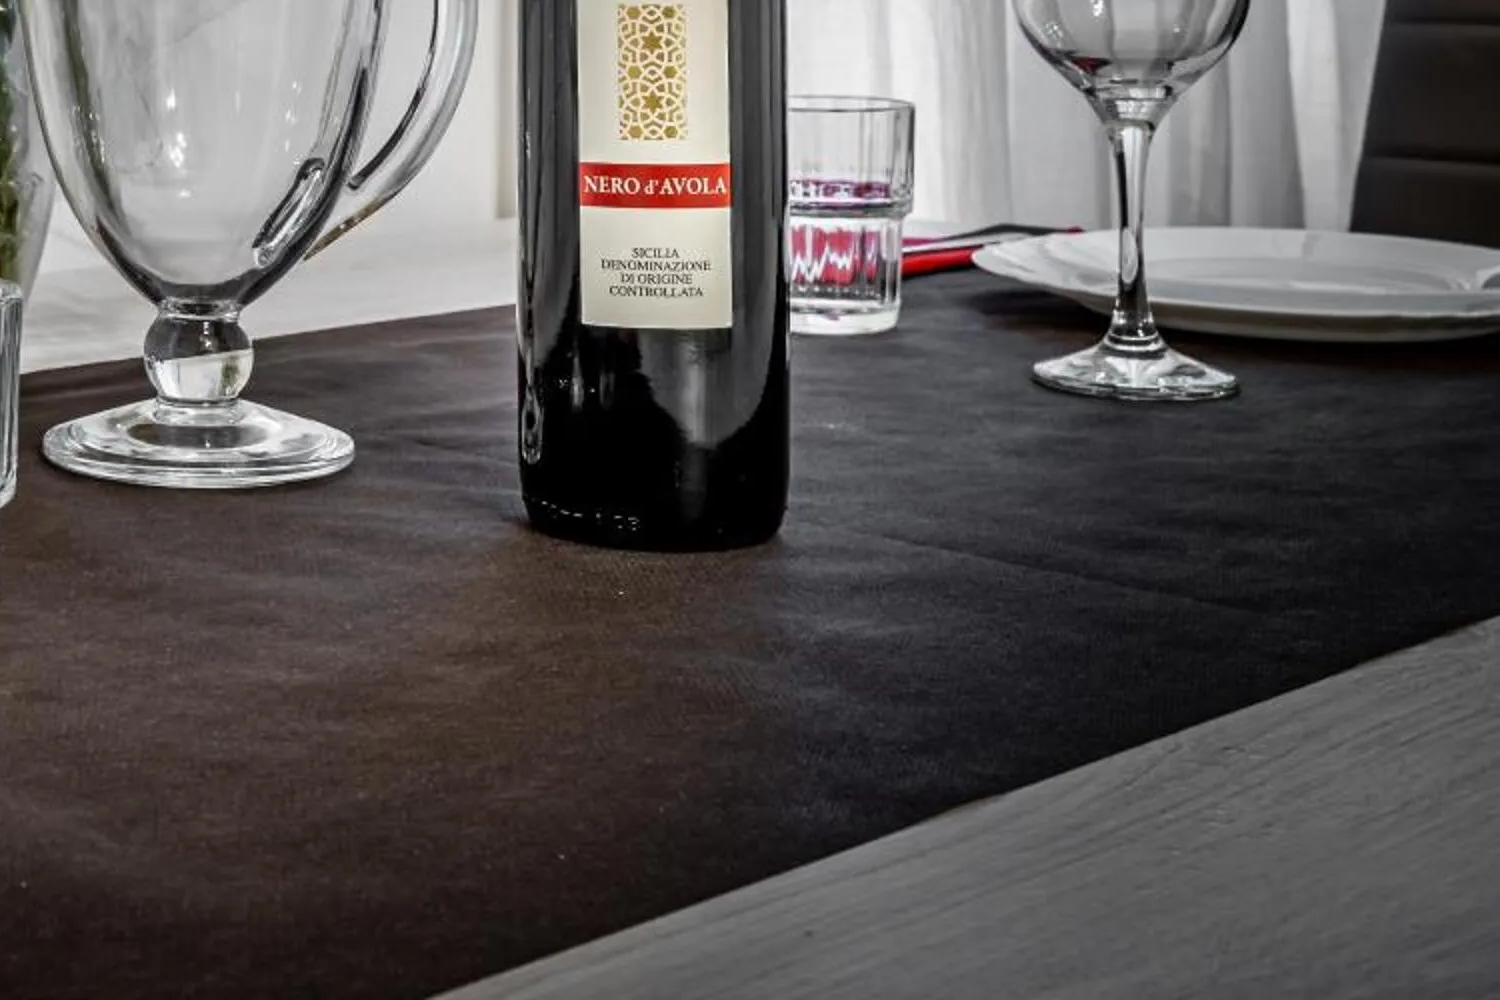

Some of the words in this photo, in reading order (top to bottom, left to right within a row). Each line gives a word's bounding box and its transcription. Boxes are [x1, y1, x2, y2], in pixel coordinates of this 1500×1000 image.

[583, 175, 641, 194] NERO
[643, 176, 727, 195] d'AVOLA
[631, 248, 680, 258] SICILIA
[601, 259, 711, 271] DENOMINAZIONE
[621, 273, 635, 284] DI
[637, 273, 693, 285] ORIGINE
[609, 286, 704, 297] CONTROLLATA
